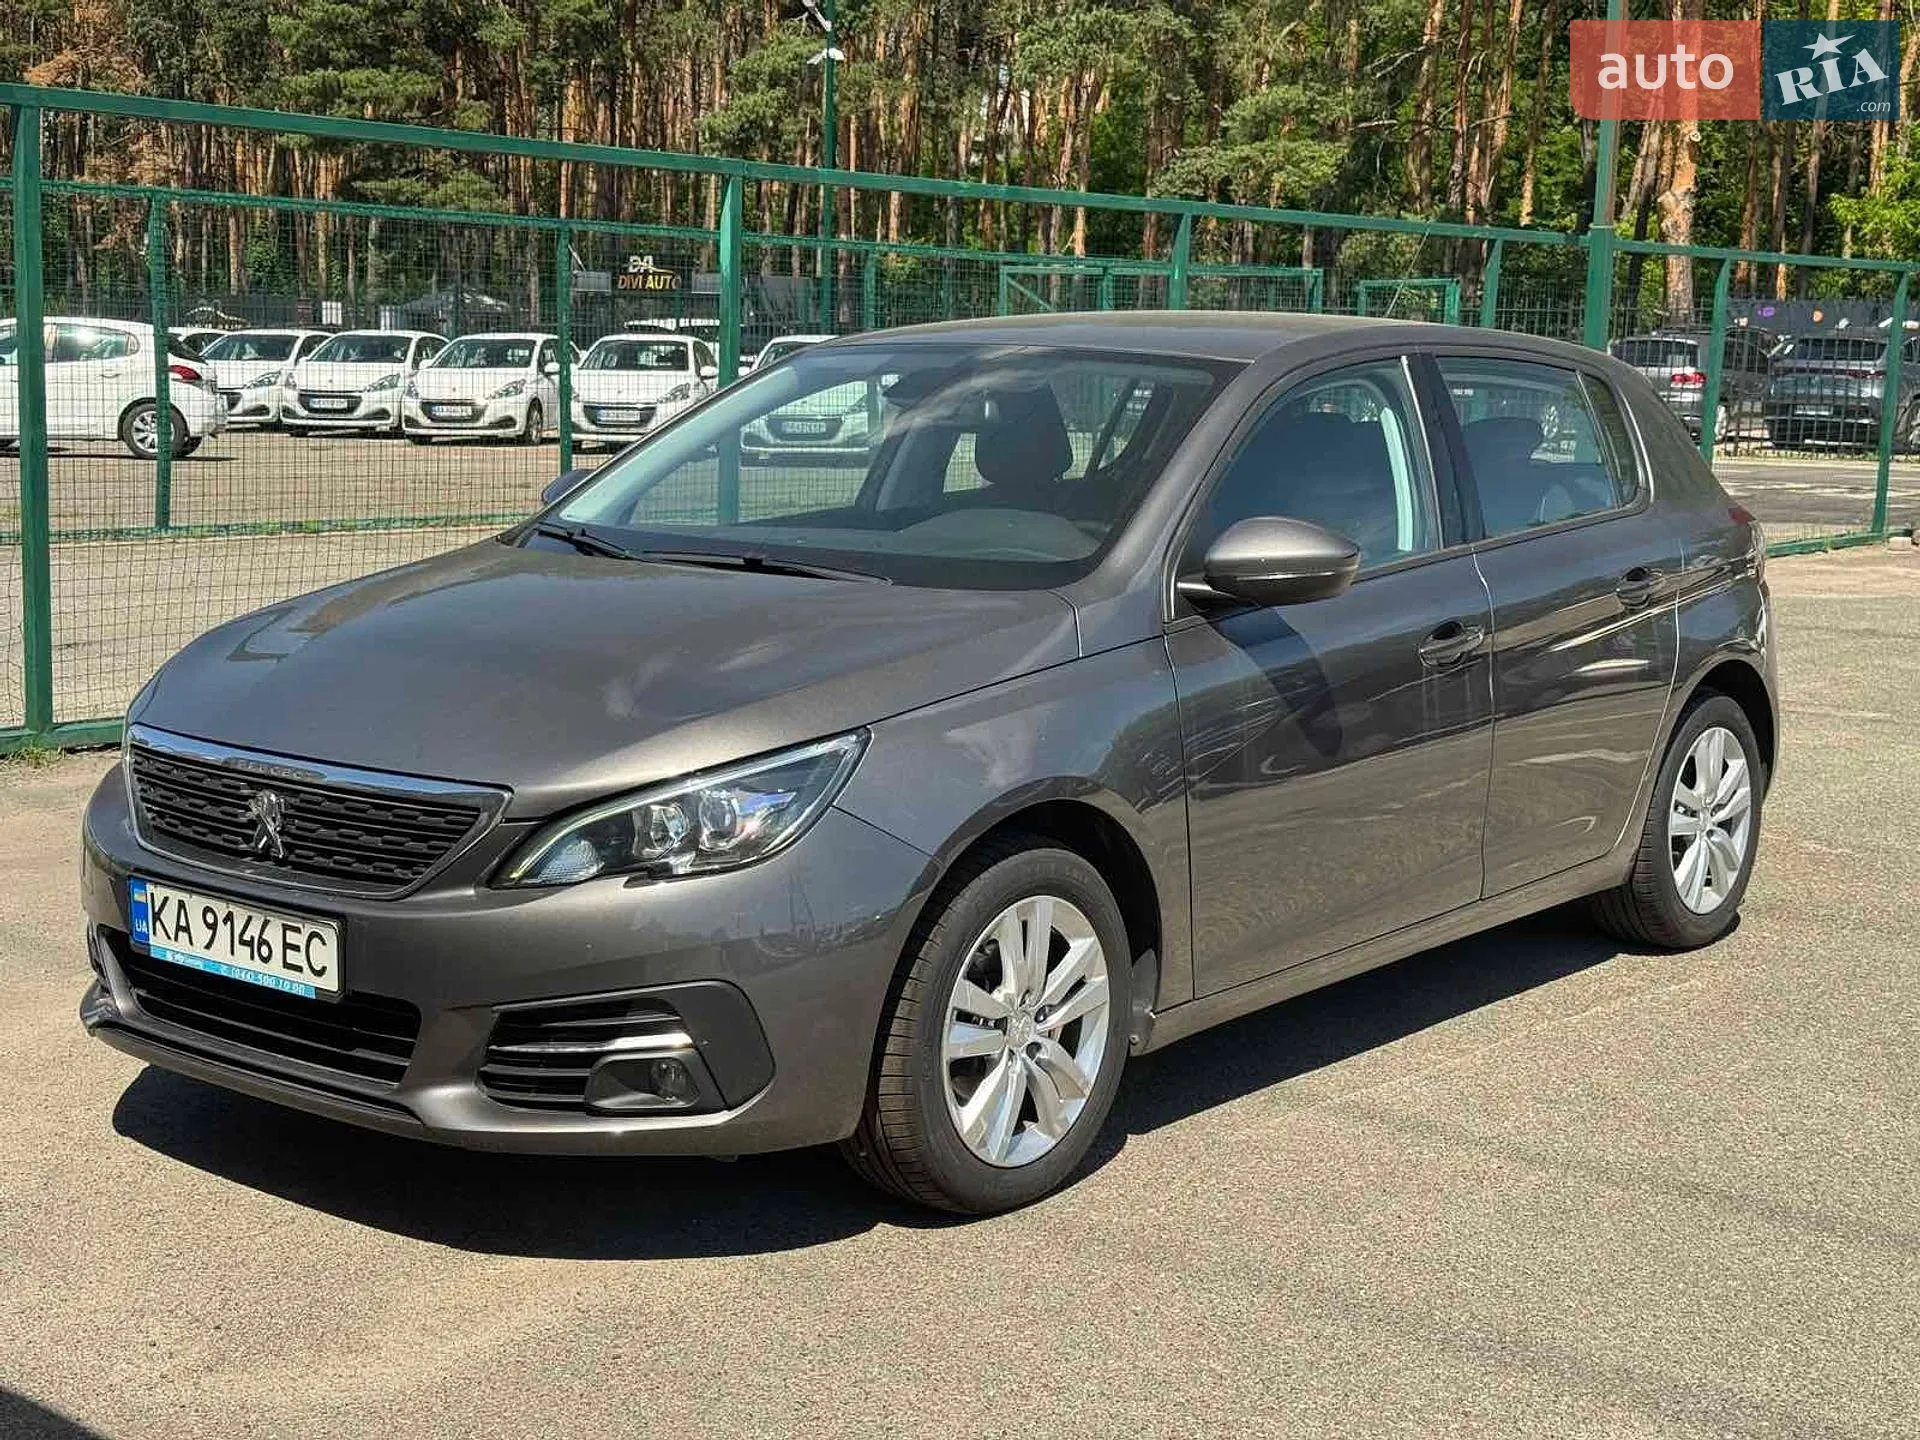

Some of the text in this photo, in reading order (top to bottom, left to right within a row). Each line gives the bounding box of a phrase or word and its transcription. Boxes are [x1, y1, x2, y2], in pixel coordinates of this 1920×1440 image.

[617, 275, 682, 290] DIVI AUTO
[135, 918, 148, 933] UA
[150, 892, 328, 977] KA 9146 EC
